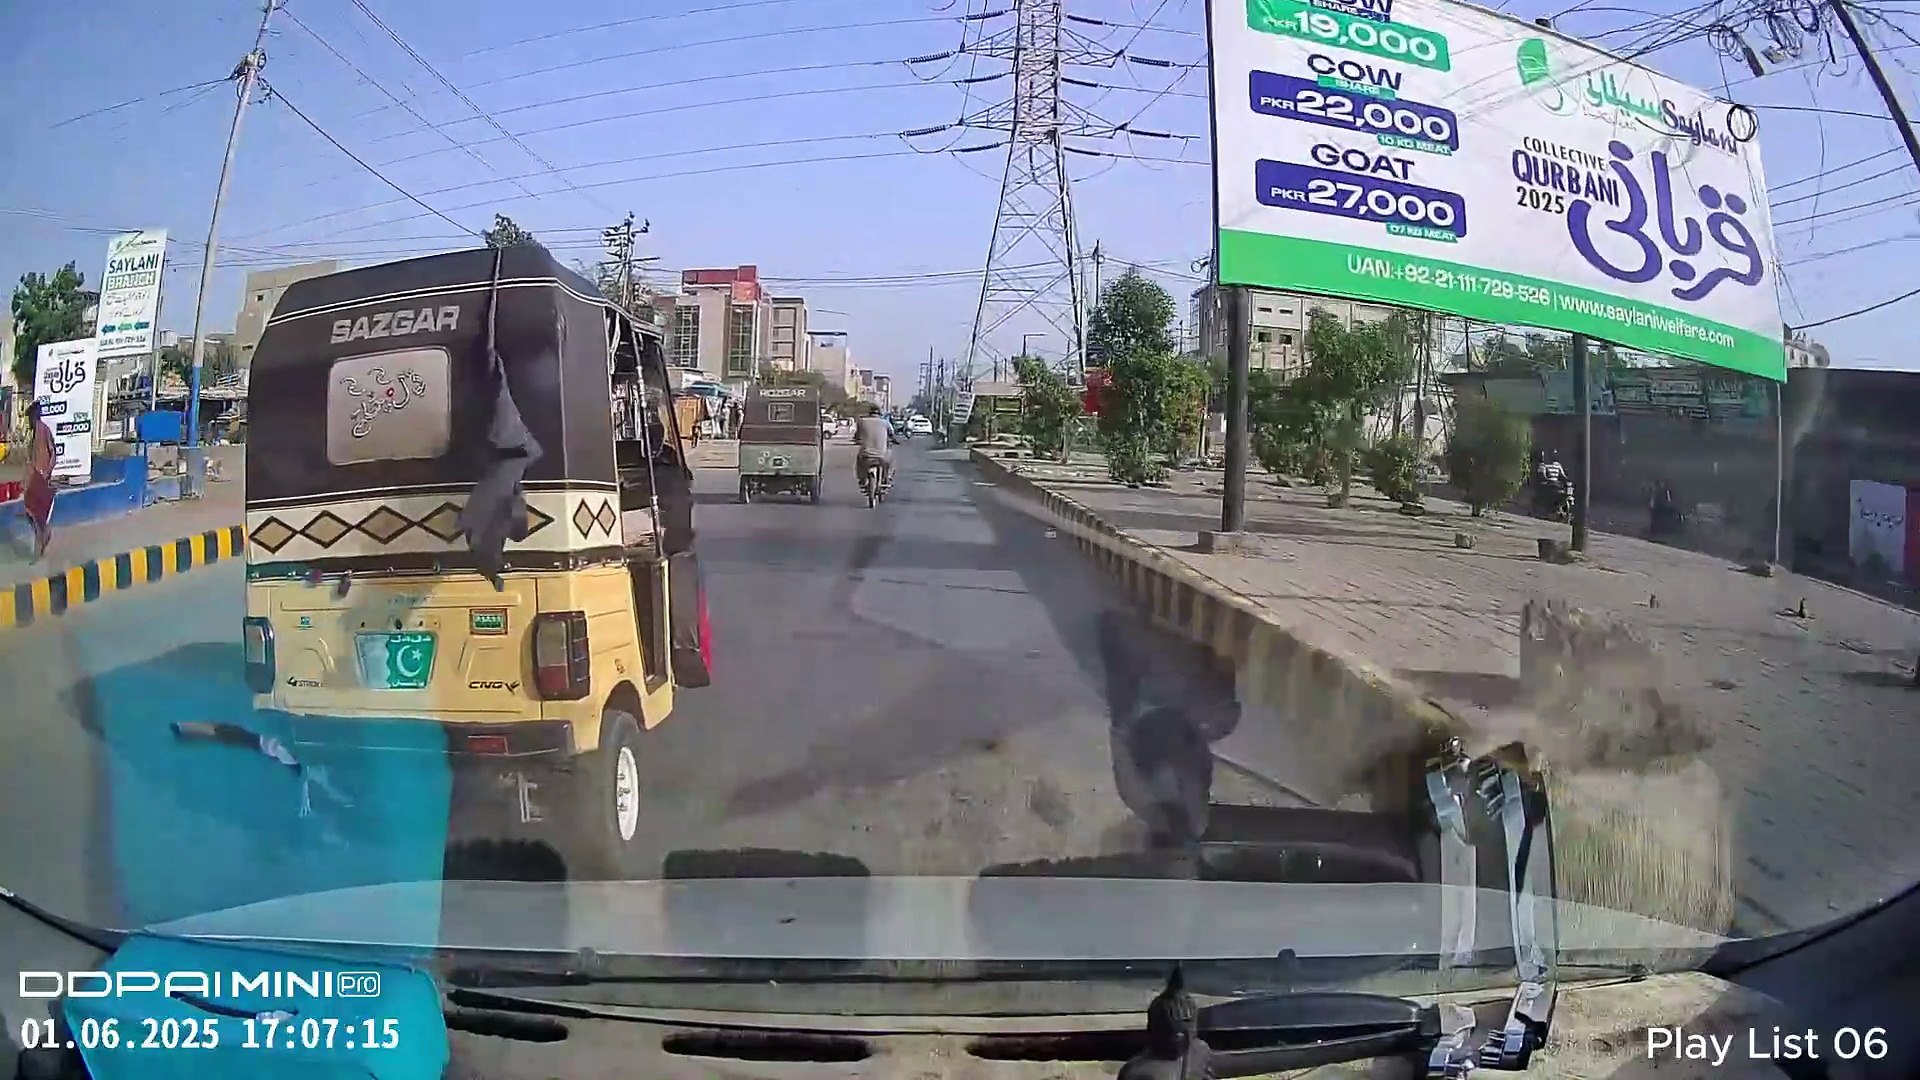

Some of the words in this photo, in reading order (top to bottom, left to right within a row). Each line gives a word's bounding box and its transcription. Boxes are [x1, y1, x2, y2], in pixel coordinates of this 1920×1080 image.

[1294, 11, 1438, 61] 19,000
[1307, 54, 1402, 90] COW
[1261, 96, 1295, 111] PKR
[1295, 90, 1450, 141] 22,000
[1310, 143, 1415, 181] GOAT
[1523, 136, 1606, 172] COLLECTIVE
[1512, 149, 1620, 207] QURBANI
[1271, 187, 1306, 202] PKR
[1307, 179, 1455, 226] 27,000
[1516, 186, 1565, 214] 2025
[108, 253, 160, 274] SAYLANI
[330, 306, 460, 345] SAZGAR
[469, 681, 503, 689] CNG
